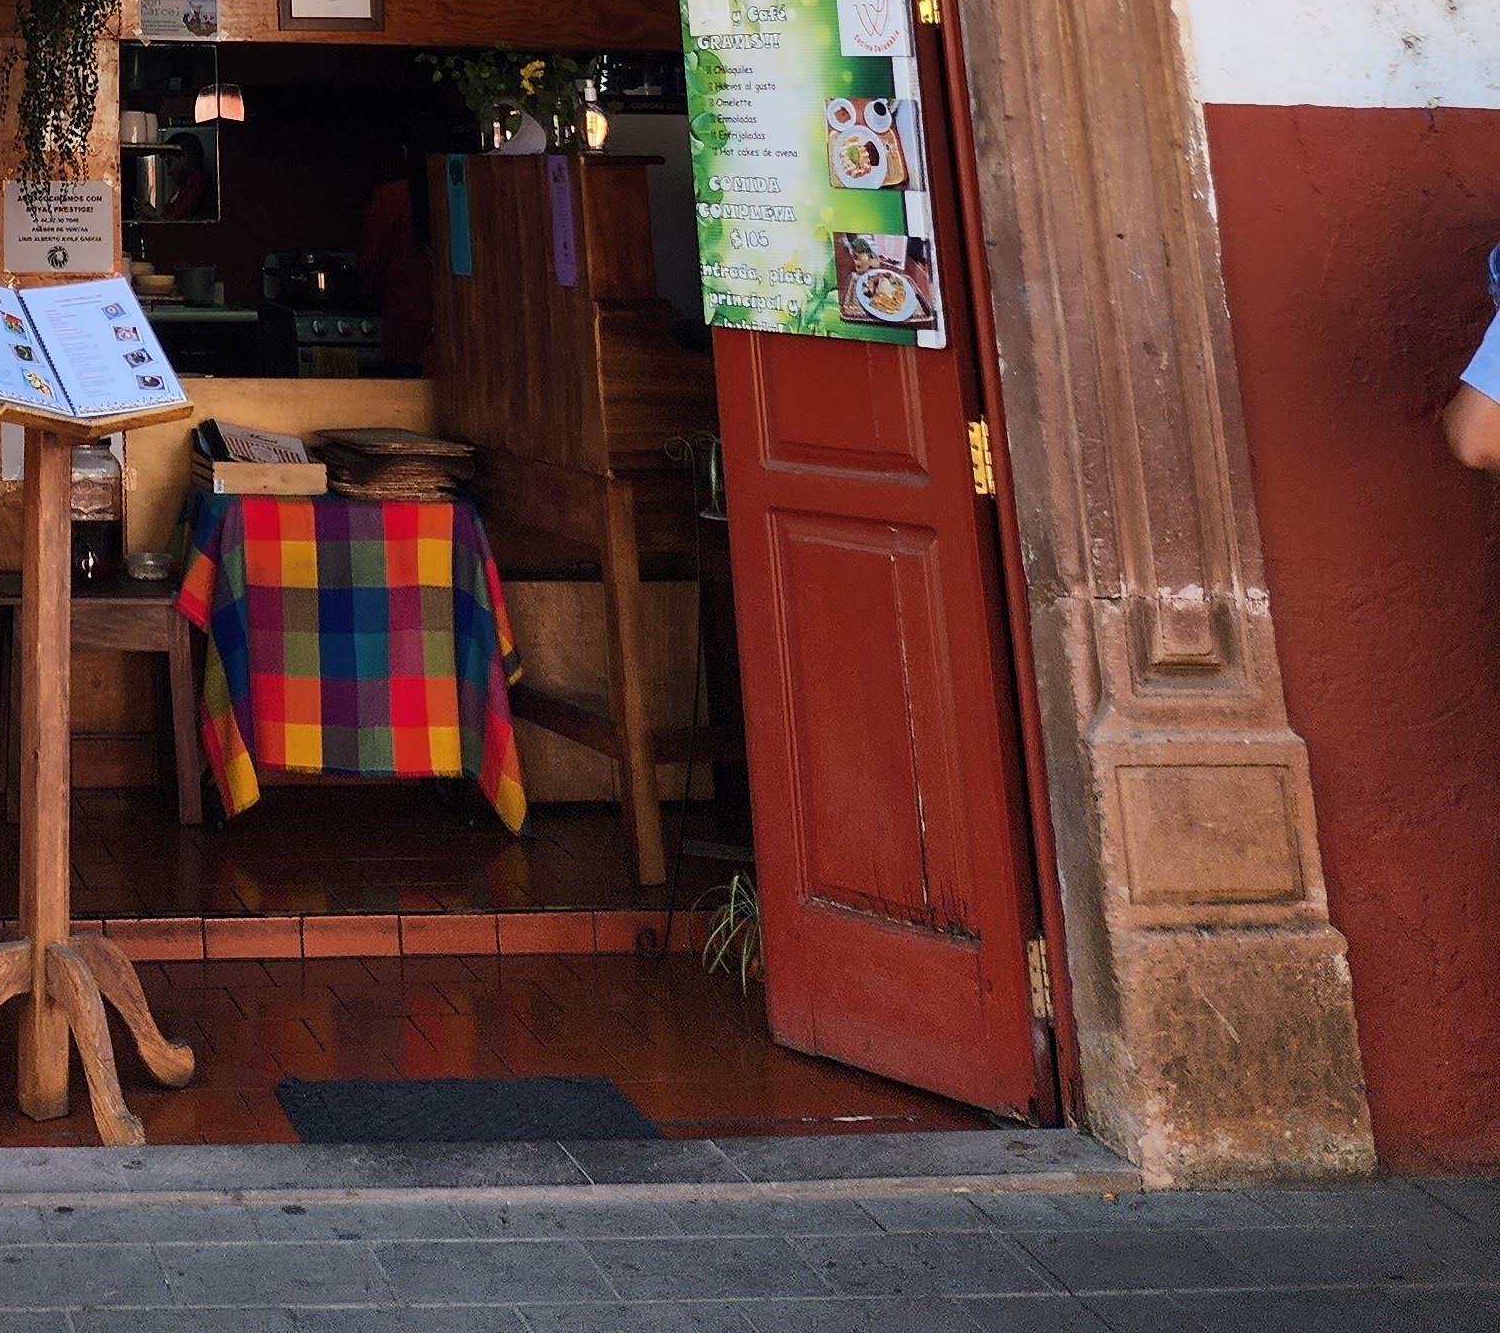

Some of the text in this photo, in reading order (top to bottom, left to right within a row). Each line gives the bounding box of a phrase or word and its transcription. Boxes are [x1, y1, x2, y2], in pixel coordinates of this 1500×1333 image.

[747, 4, 787, 23] Café
[697, 33, 781, 50] GRATIS!!
[713, 65, 754, 77] Chilaquiles
[715, 81, 776, 94] Huevos al gusto
[716, 98, 753, 108] Omelette
[717, 113, 757, 124] Enmoladas
[718, 129, 766, 142] Enfrijoladas
[720, 147, 798, 158] Hot cakes de avena
[708, 175, 782, 194] COMIDA
[85, 195, 103, 203] CON
[698, 202, 797, 223] COMPLETA
[730, 228, 770, 250] $105
[768, 267, 813, 287] plato
[709, 291, 801, 316] principal y
